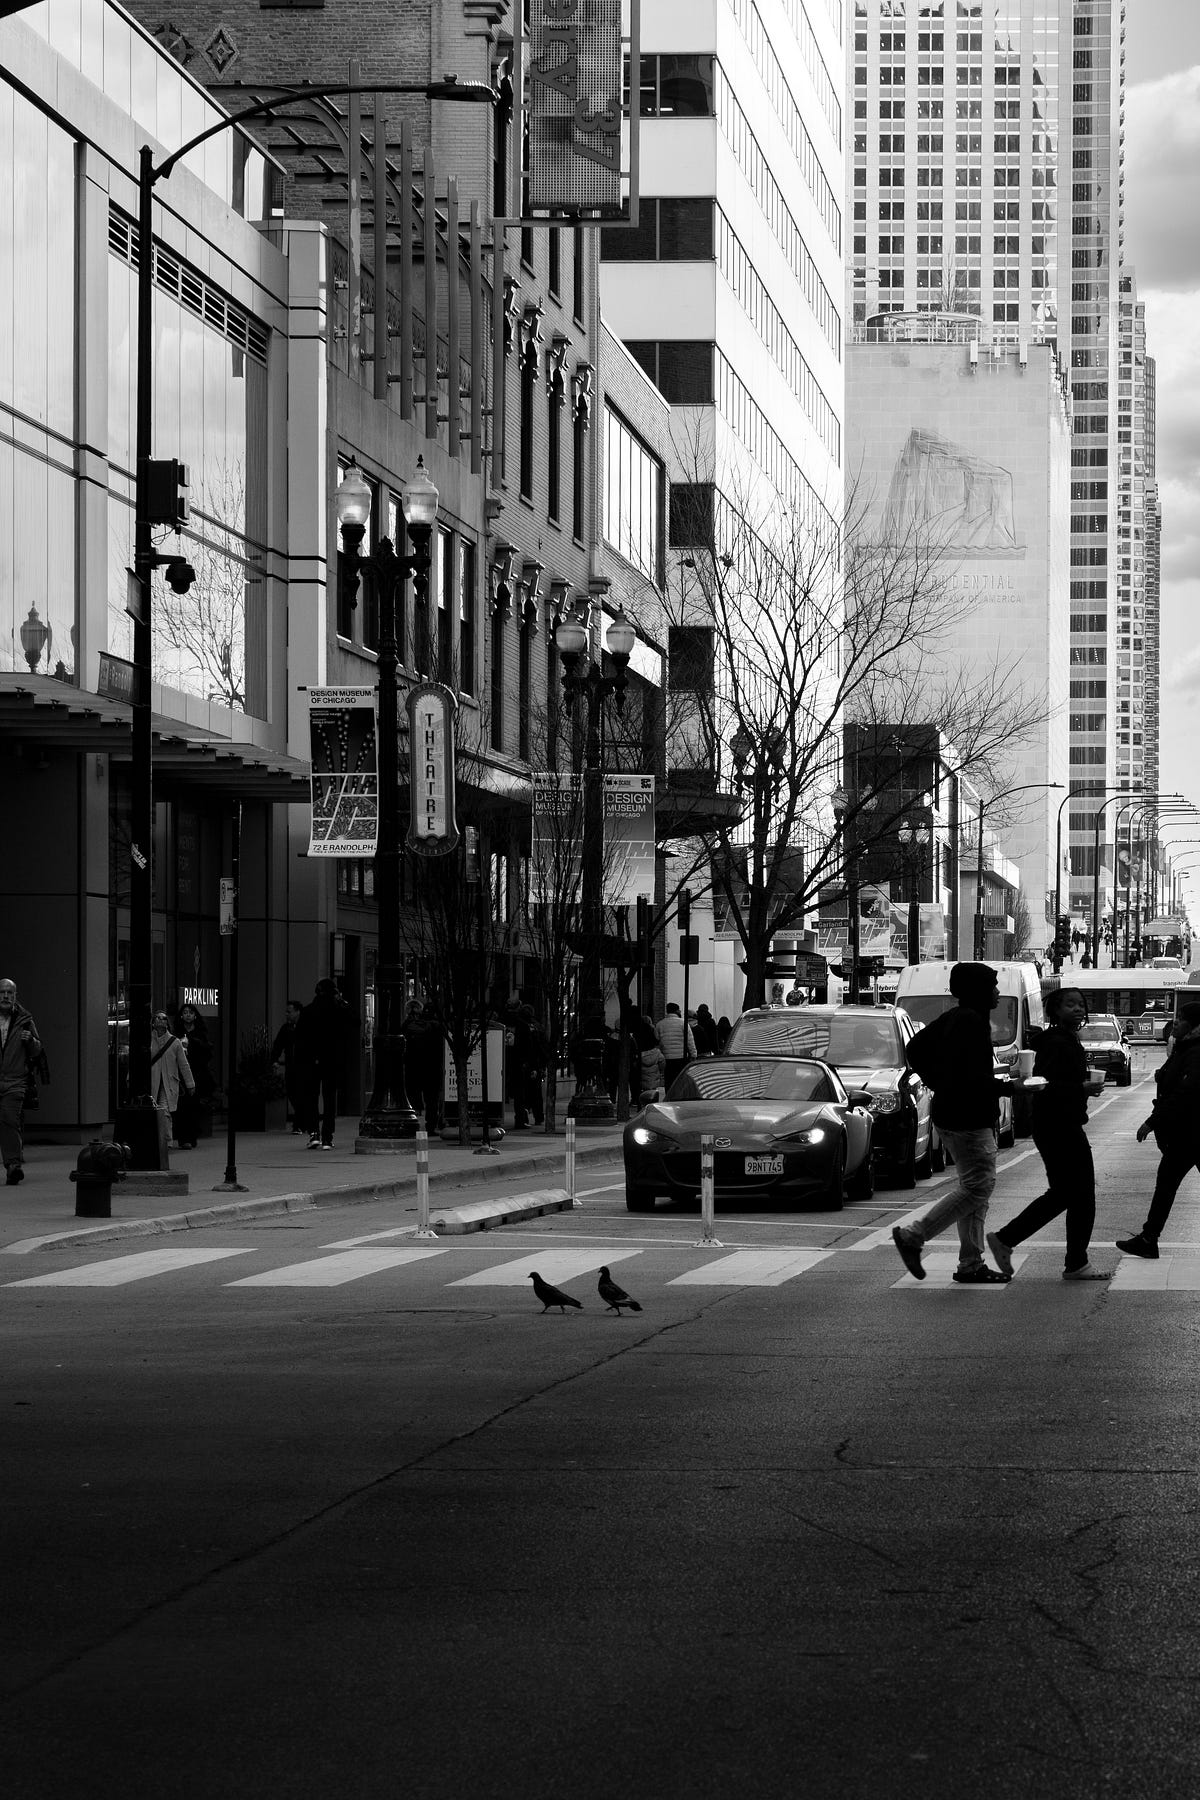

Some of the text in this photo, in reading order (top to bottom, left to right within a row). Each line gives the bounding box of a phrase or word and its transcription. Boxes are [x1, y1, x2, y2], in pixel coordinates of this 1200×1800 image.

[574, 99, 621, 170] 37
[425, 713, 436, 831] THEATRE
[606, 793, 652, 804] DESIGN
[606, 804, 647, 812] MUSEUM
[818, 921, 843, 929] Garland
[184, 987, 219, 1005] PARKLINE
